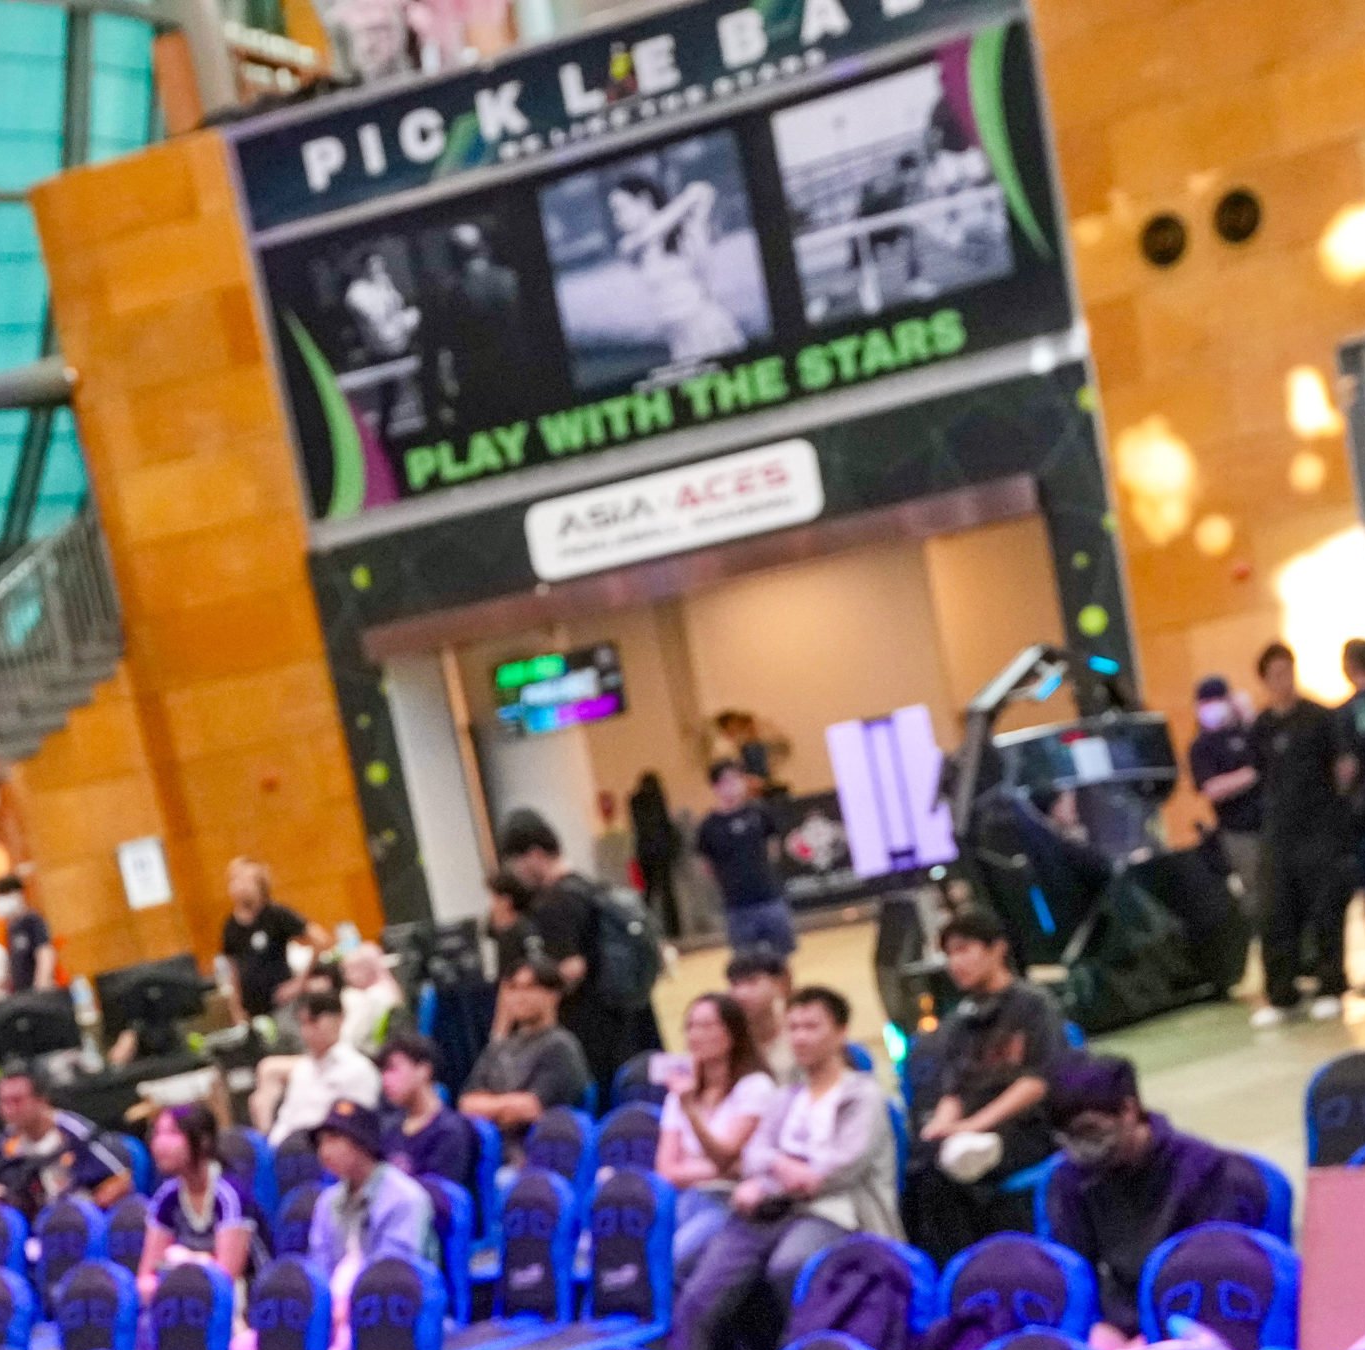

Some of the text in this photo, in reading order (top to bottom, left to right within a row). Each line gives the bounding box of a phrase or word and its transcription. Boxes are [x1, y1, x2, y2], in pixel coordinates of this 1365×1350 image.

[404, 309, 968, 490] PLAY WITH THE STARS
